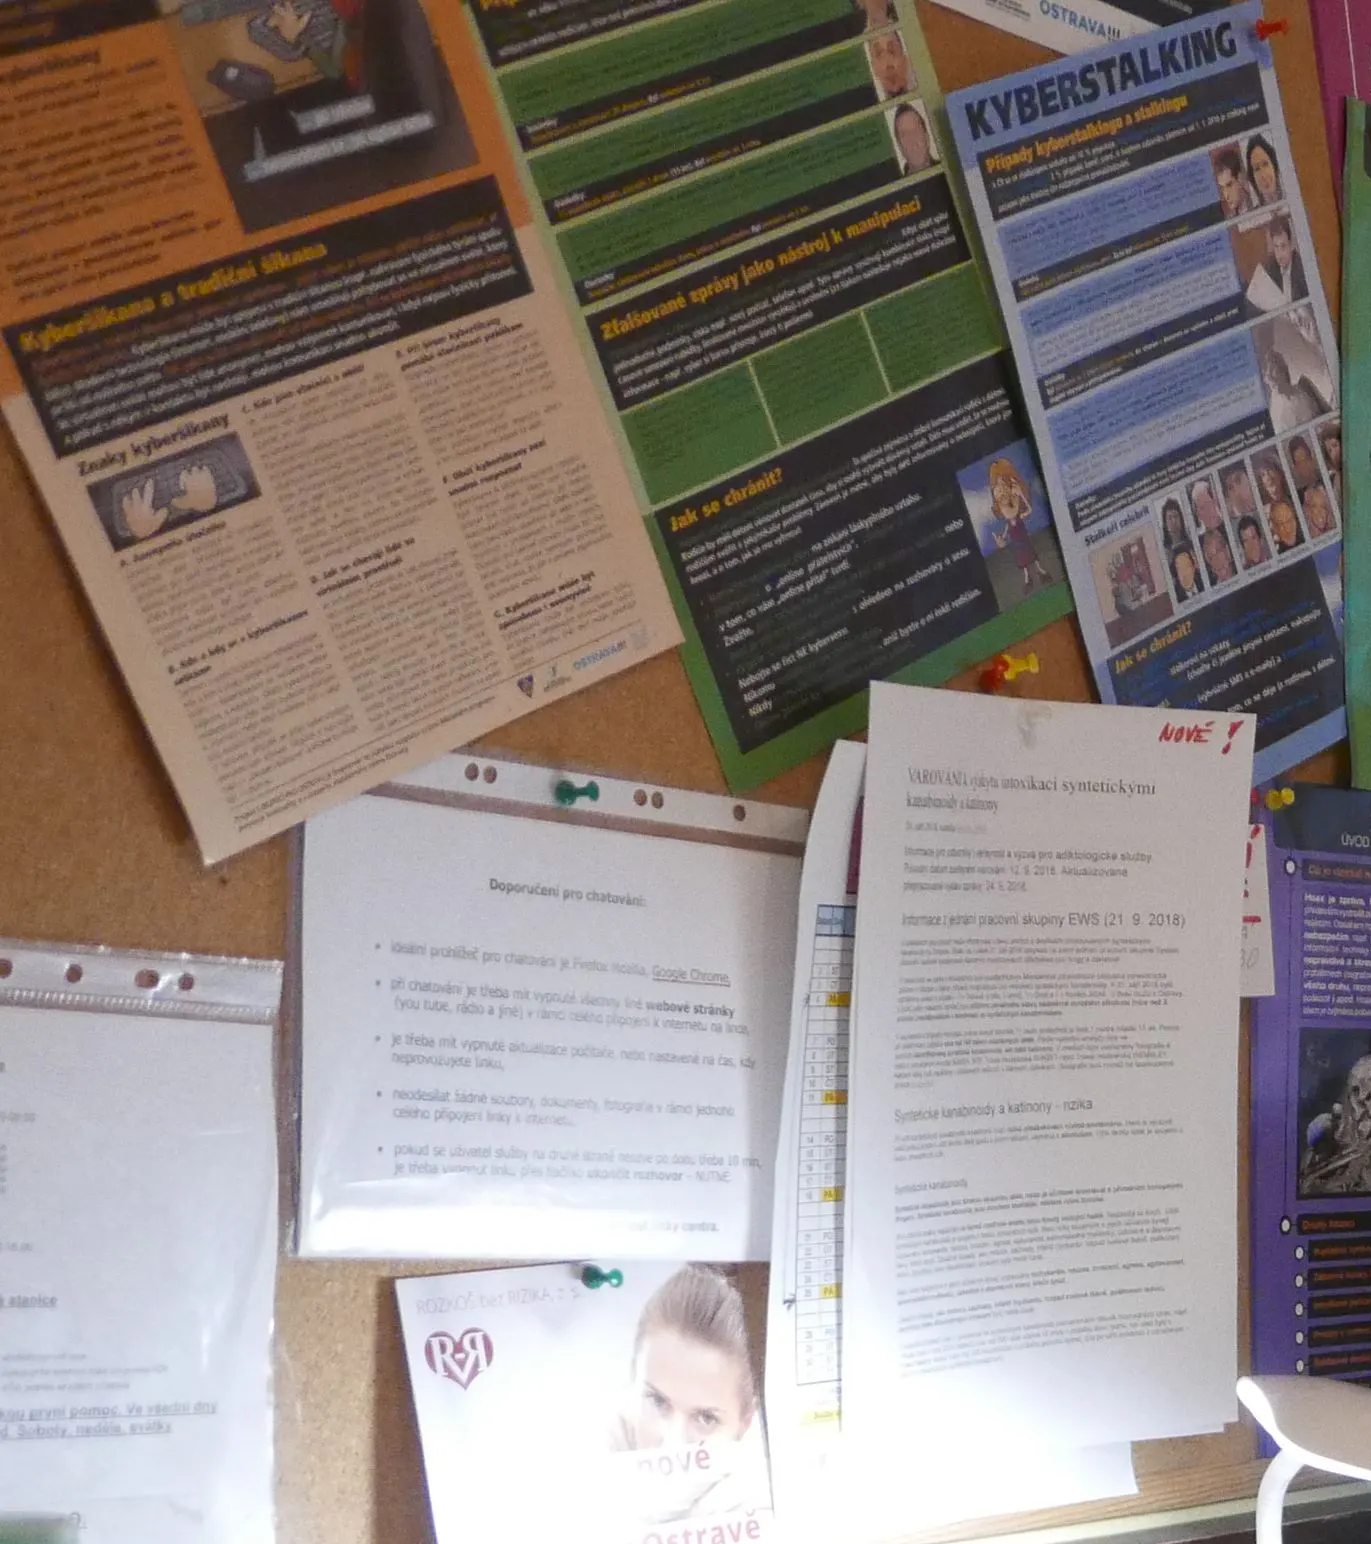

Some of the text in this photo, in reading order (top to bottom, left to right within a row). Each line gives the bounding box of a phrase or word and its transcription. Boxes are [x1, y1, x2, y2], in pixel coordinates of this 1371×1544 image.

[965, 21, 1237, 140] KYBERSTALKING
[846, 198, 923, 239] manipulaci
[669, 466, 784, 534] Jak se chránit?
[1159, 720, 1216, 744] NOVÉ
[1342, 832, 1370, 849] ÚVOD
[490, 878, 561, 898] Doporučení
[562, 888, 583, 902] pro
[1068, 912, 1099, 926] EWS
[1148, 912, 1186, 928] 2018)
[652, 964, 688, 982] Google
[693, 1001, 736, 1020] stránky
